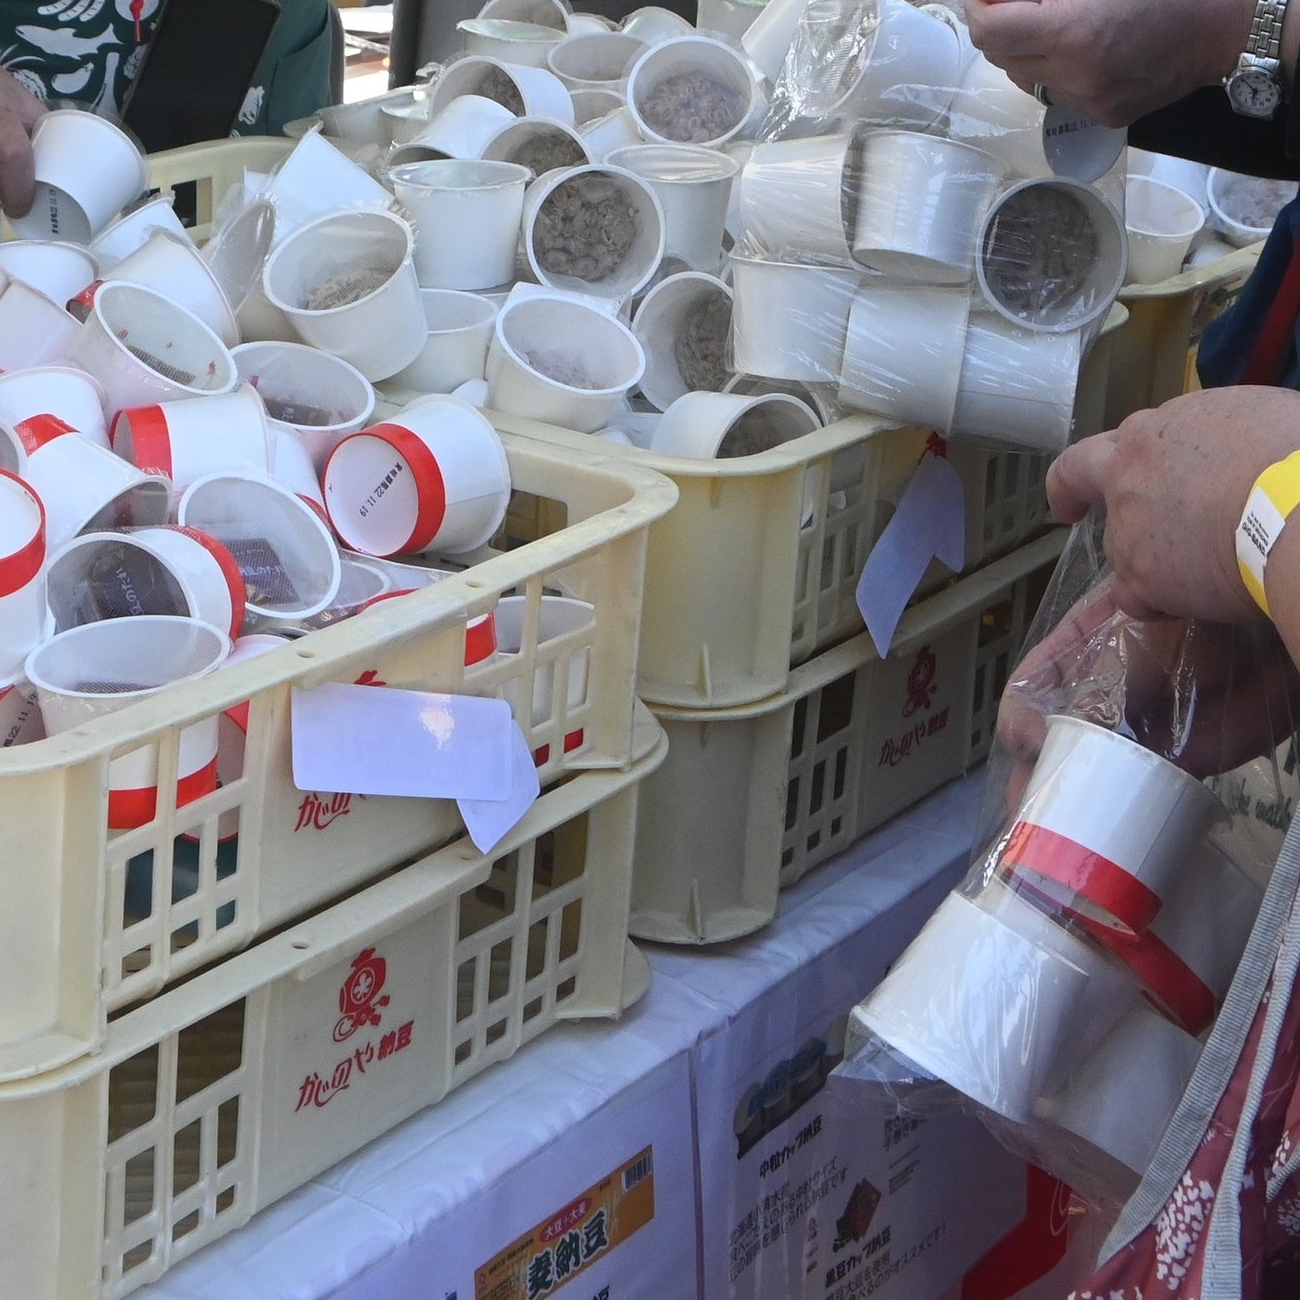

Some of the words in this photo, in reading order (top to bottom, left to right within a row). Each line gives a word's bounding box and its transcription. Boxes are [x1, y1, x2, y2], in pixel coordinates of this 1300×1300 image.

[115, 566, 144, 615] 豆のたれ
[295, 1019, 415, 1112] かじのや納豆
[760, 1114, 822, 1179] 中粒カップ納豆
[528, 1208, 608, 1300] 麦納豆
[825, 1225, 891, 1289] 黒豆カップ納豆
